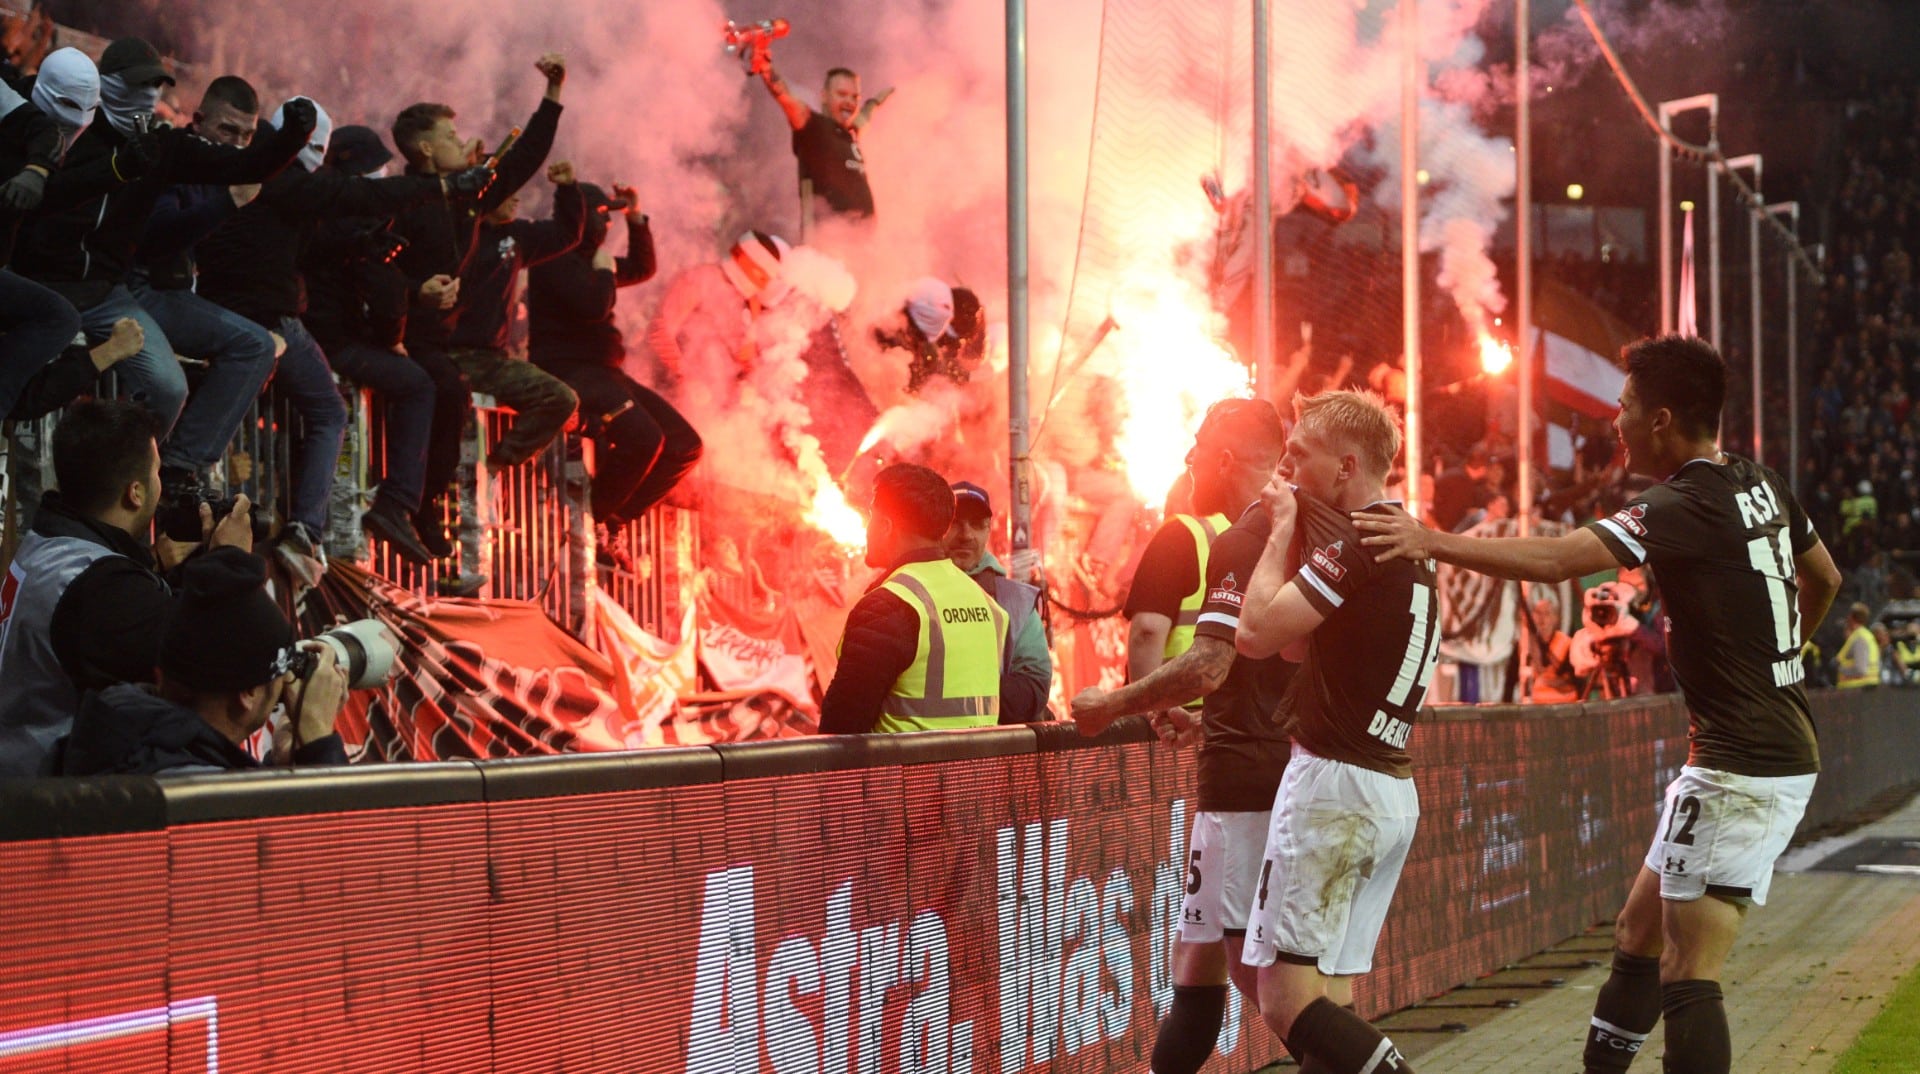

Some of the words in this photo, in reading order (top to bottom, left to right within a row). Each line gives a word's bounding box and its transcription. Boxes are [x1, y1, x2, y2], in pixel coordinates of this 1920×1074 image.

[1312, 552, 1340, 577] ASTRA
[942, 606, 991, 624] ORDNER
[1211, 591, 1241, 604] ASTRA
[1663, 794, 1701, 847] 12
[1186, 850, 1202, 896] 5
[996, 818, 1135, 1074] Was
